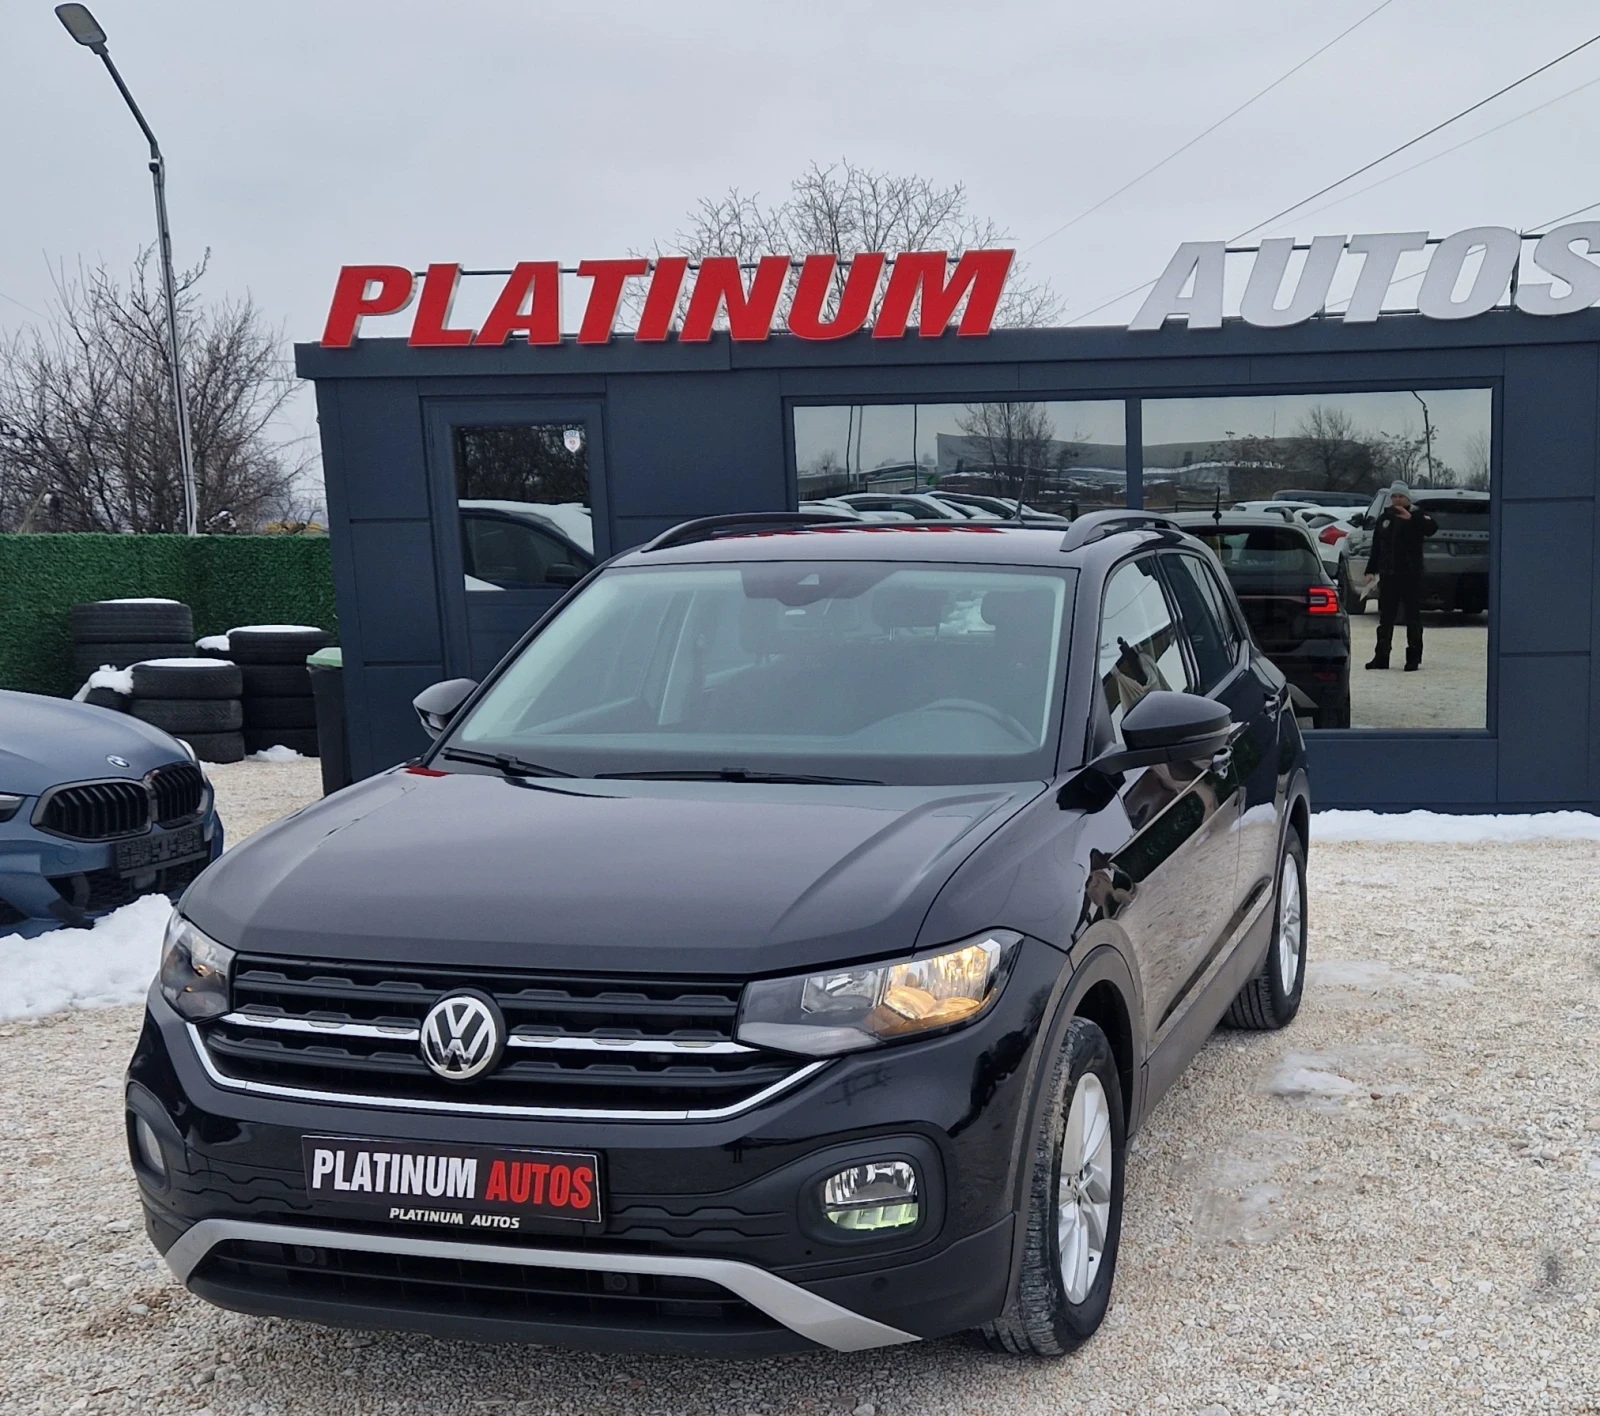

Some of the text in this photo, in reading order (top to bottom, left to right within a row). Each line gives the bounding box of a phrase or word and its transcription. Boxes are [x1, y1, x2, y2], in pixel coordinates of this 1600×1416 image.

[320, 221, 1600, 347] PLATINUM AUTOS
[312, 1149, 593, 1209] PLATINUM AUTOS
[389, 1207, 520, 1229] PLATINUM AUTOS
